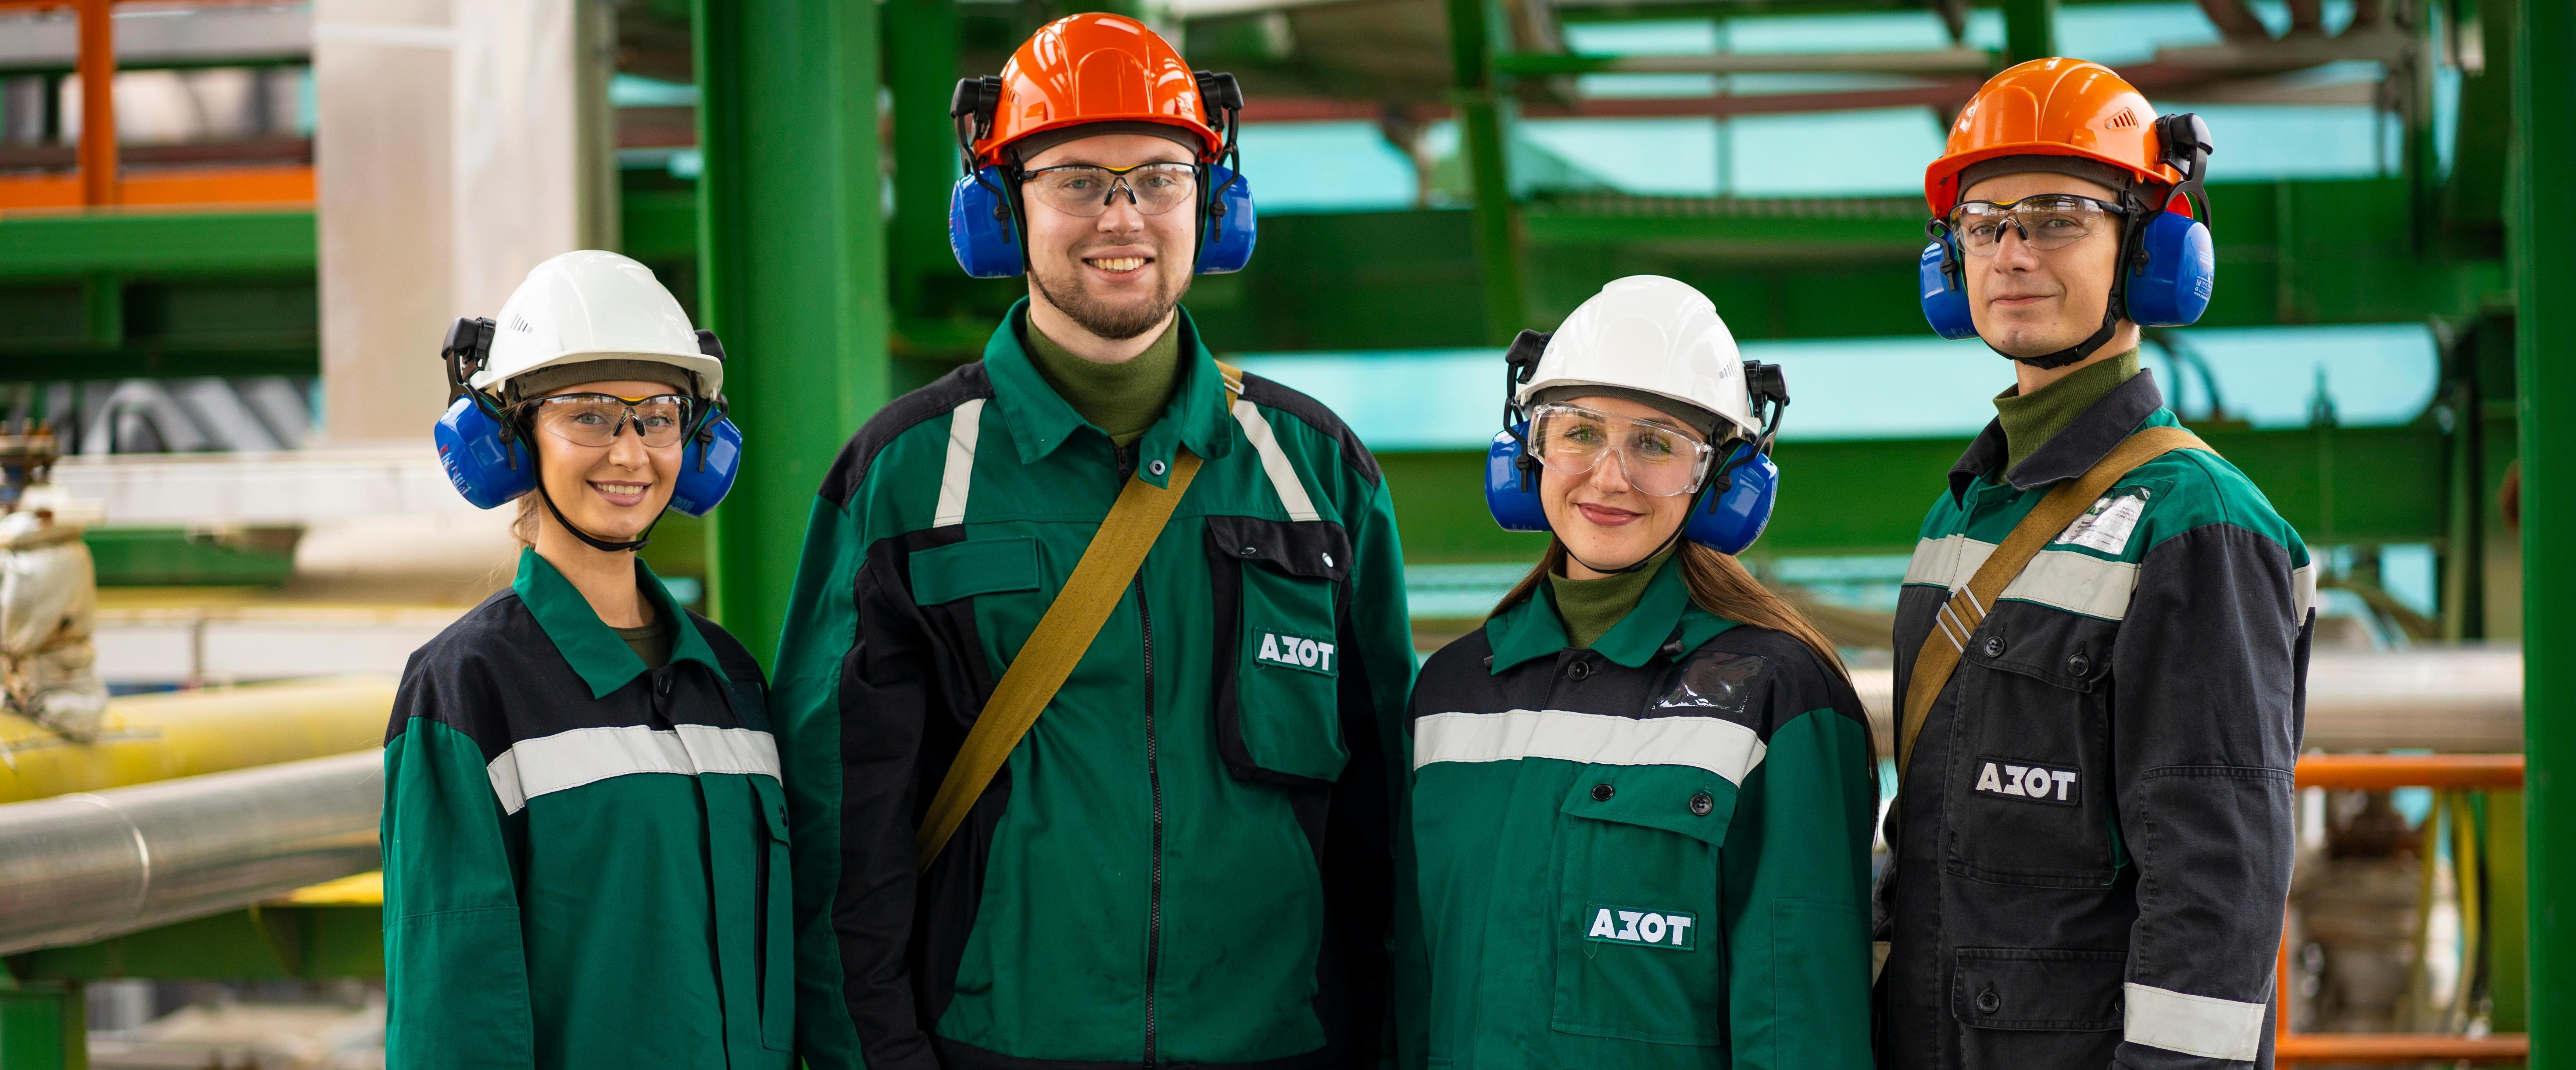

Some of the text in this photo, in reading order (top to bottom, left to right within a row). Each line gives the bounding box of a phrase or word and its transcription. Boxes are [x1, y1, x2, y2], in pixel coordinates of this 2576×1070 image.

[1259, 633, 1334, 671] АЗОТ
[1976, 762, 2076, 800] АЗОТ
[1589, 908, 1691, 945] АЗОТ
